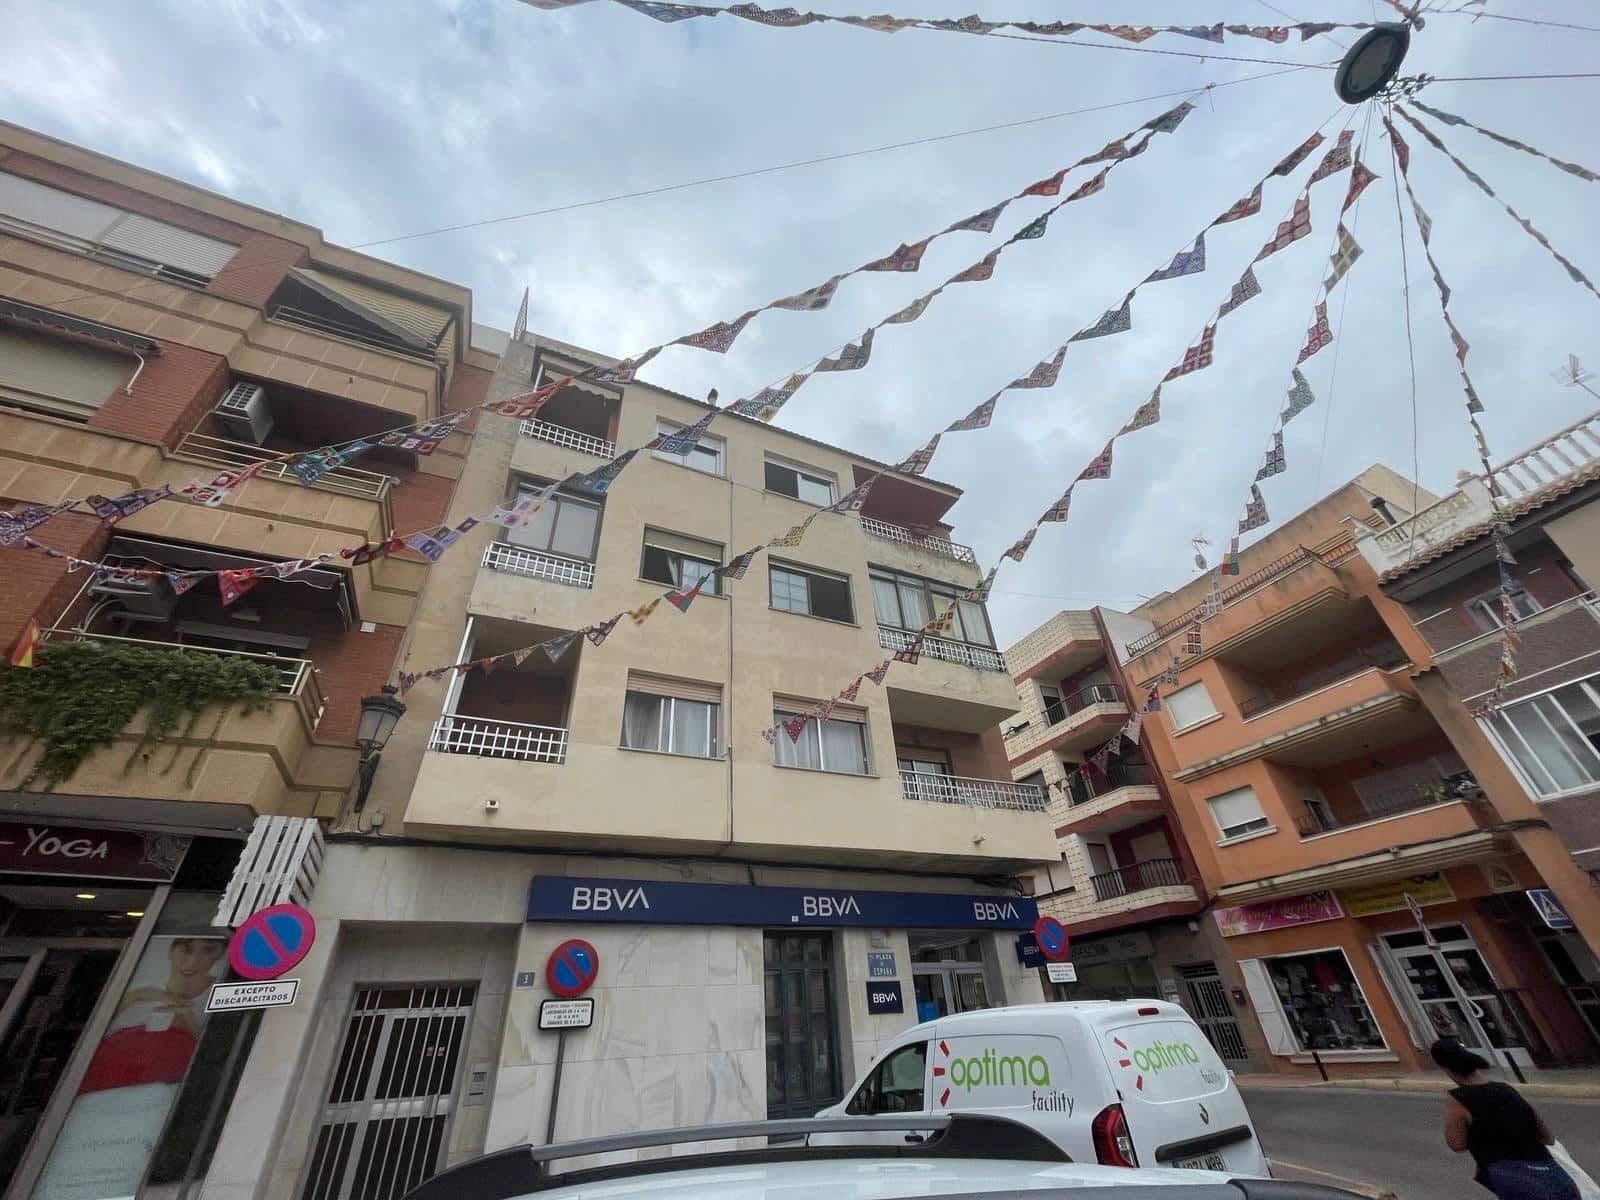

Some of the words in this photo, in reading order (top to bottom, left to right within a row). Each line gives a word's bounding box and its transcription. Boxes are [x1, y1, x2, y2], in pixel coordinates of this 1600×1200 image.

[20, 827, 109, 859] YOGA
[571, 886, 650, 911] BBVA
[803, 895, 861, 917] BBVA
[973, 902, 1020, 921] BBVA
[214, 994, 289, 1006] DISCAPACITADOS
[234, 986, 276, 995] EXCEPTO
[872, 992, 897, 1003] BBVA
[1132, 1039, 1199, 1074] optima
[950, 1048, 1050, 1093] optima
[1032, 1090, 1075, 1118] facility
